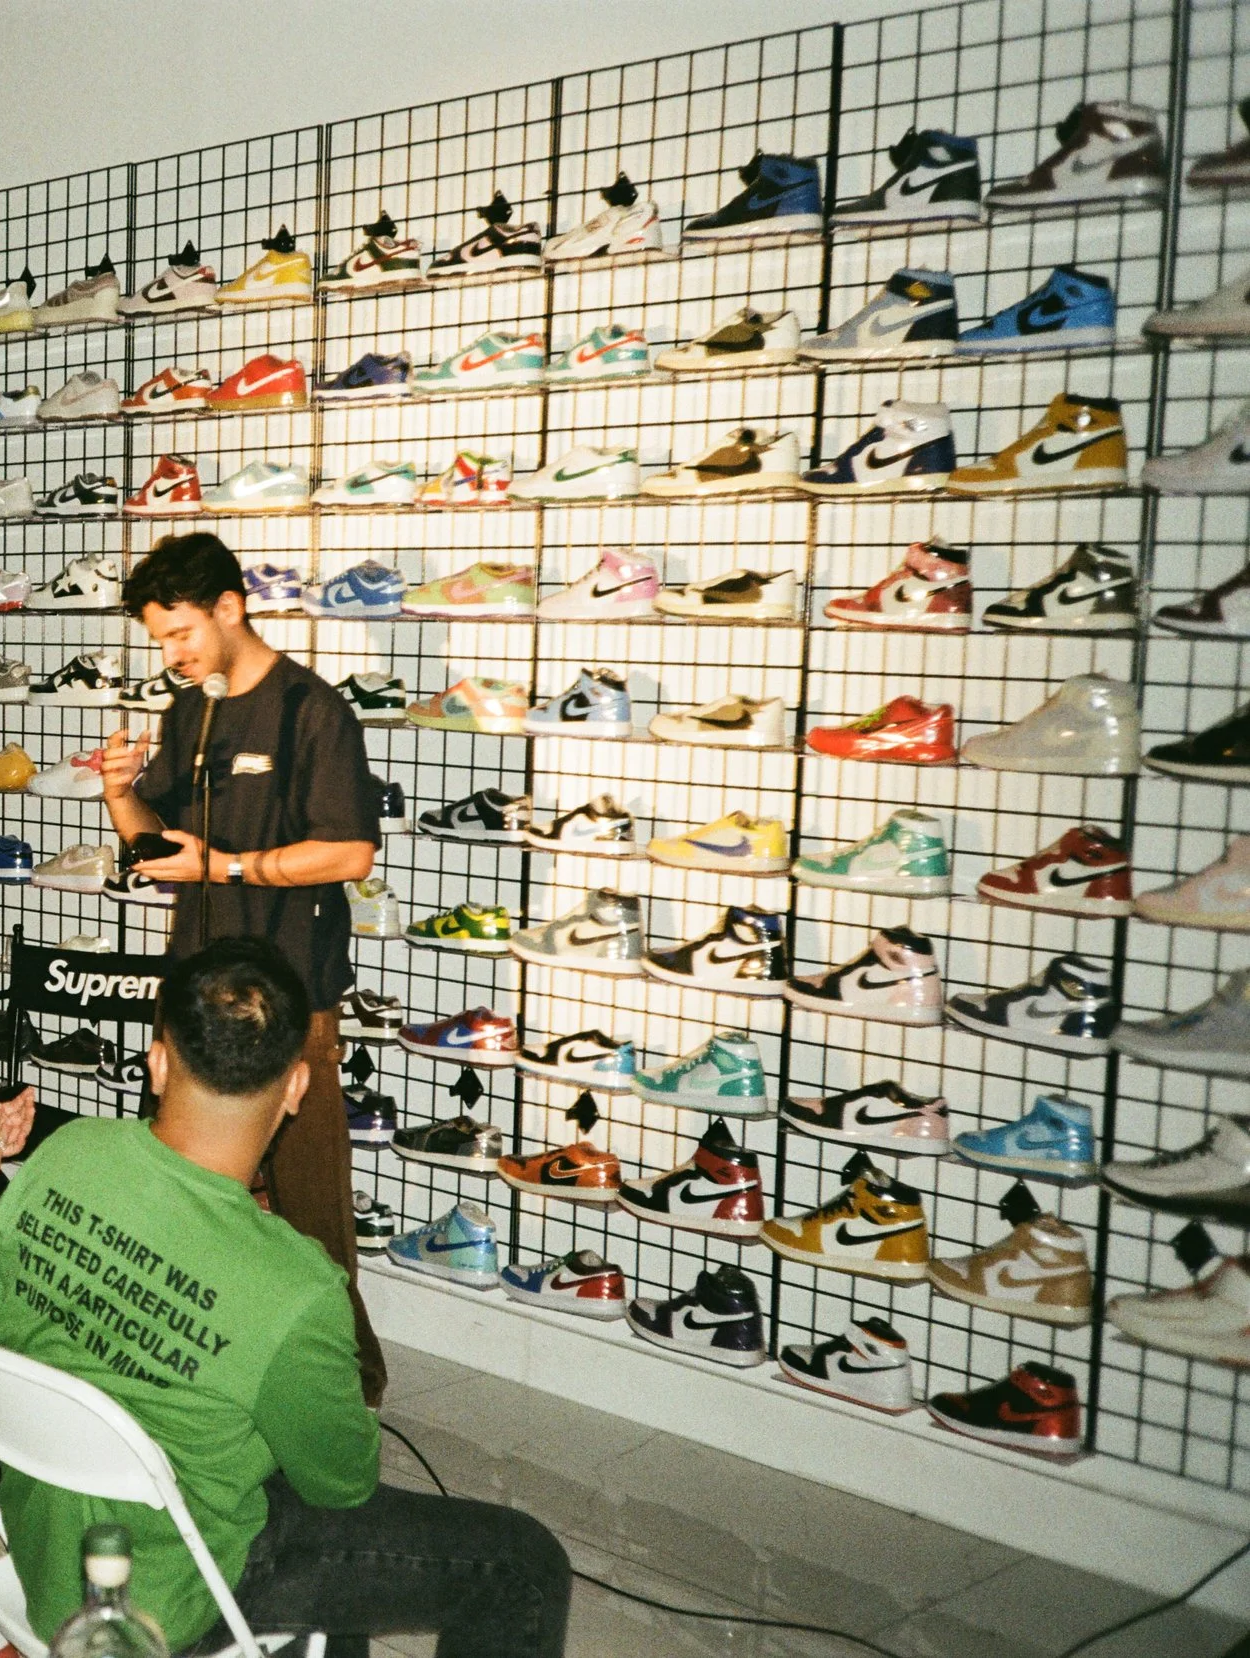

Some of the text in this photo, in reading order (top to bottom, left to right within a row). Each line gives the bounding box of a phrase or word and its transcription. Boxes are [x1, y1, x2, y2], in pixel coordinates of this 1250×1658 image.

[44, 959, 162, 1007] Suprem
[42, 1189, 217, 1311] THIS T-SHIRT WAS
[17, 1212, 230, 1356] SELECTED CAREFULLY
[56, 1275, 70, 1298] A
[84, 1331, 110, 1360] IN
